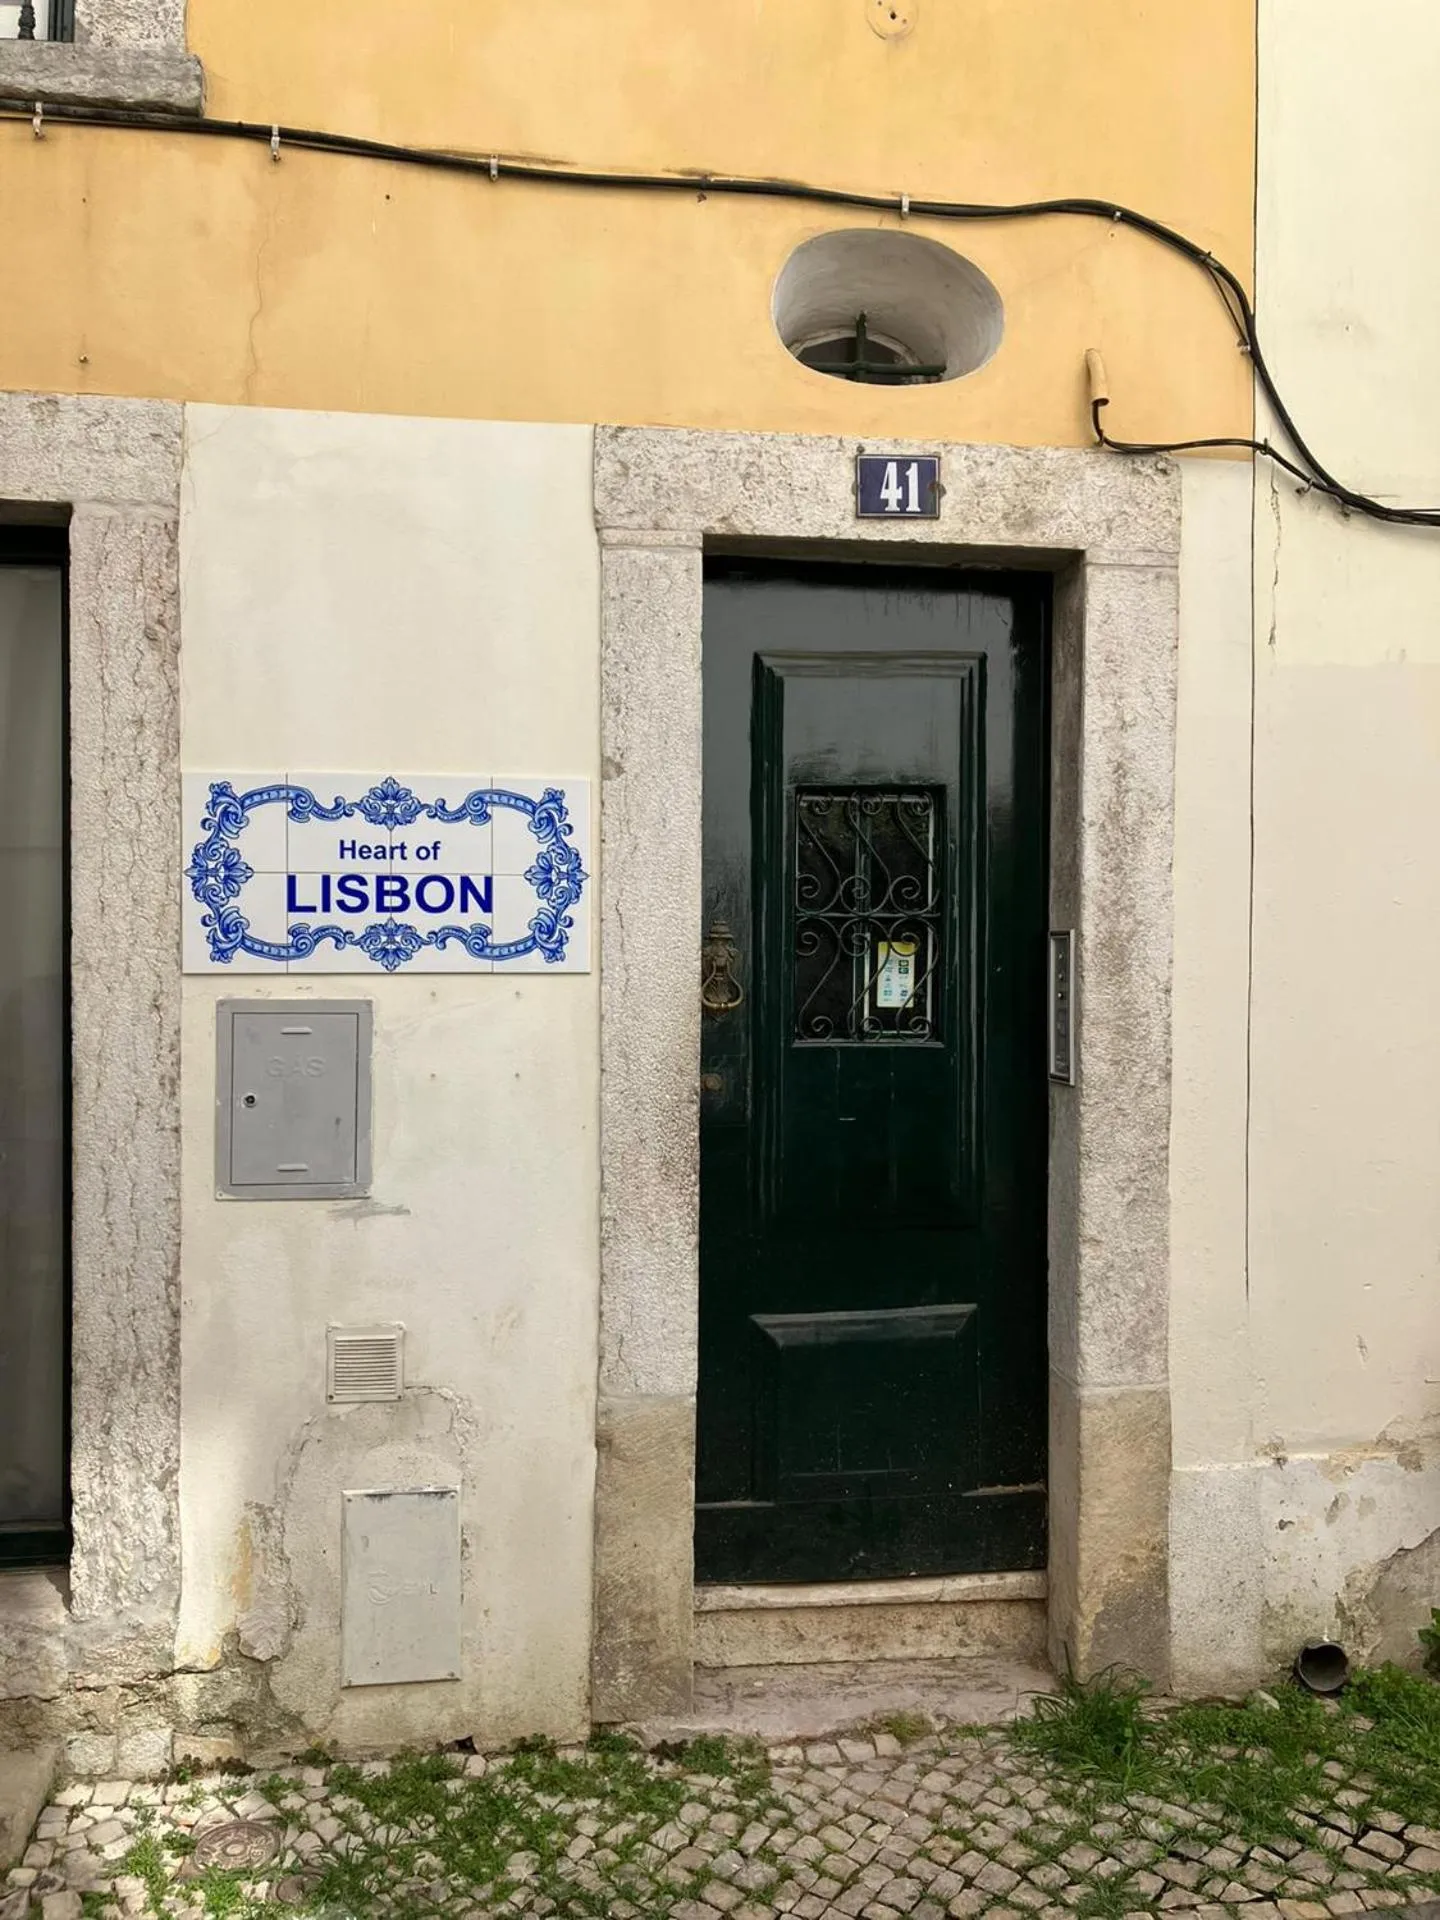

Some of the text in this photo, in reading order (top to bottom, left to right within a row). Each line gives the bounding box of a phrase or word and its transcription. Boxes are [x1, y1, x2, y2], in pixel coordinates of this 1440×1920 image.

[880, 461, 921, 512] 41
[339, 839, 441, 861] Heart of
[287, 874, 493, 914] LISBON
